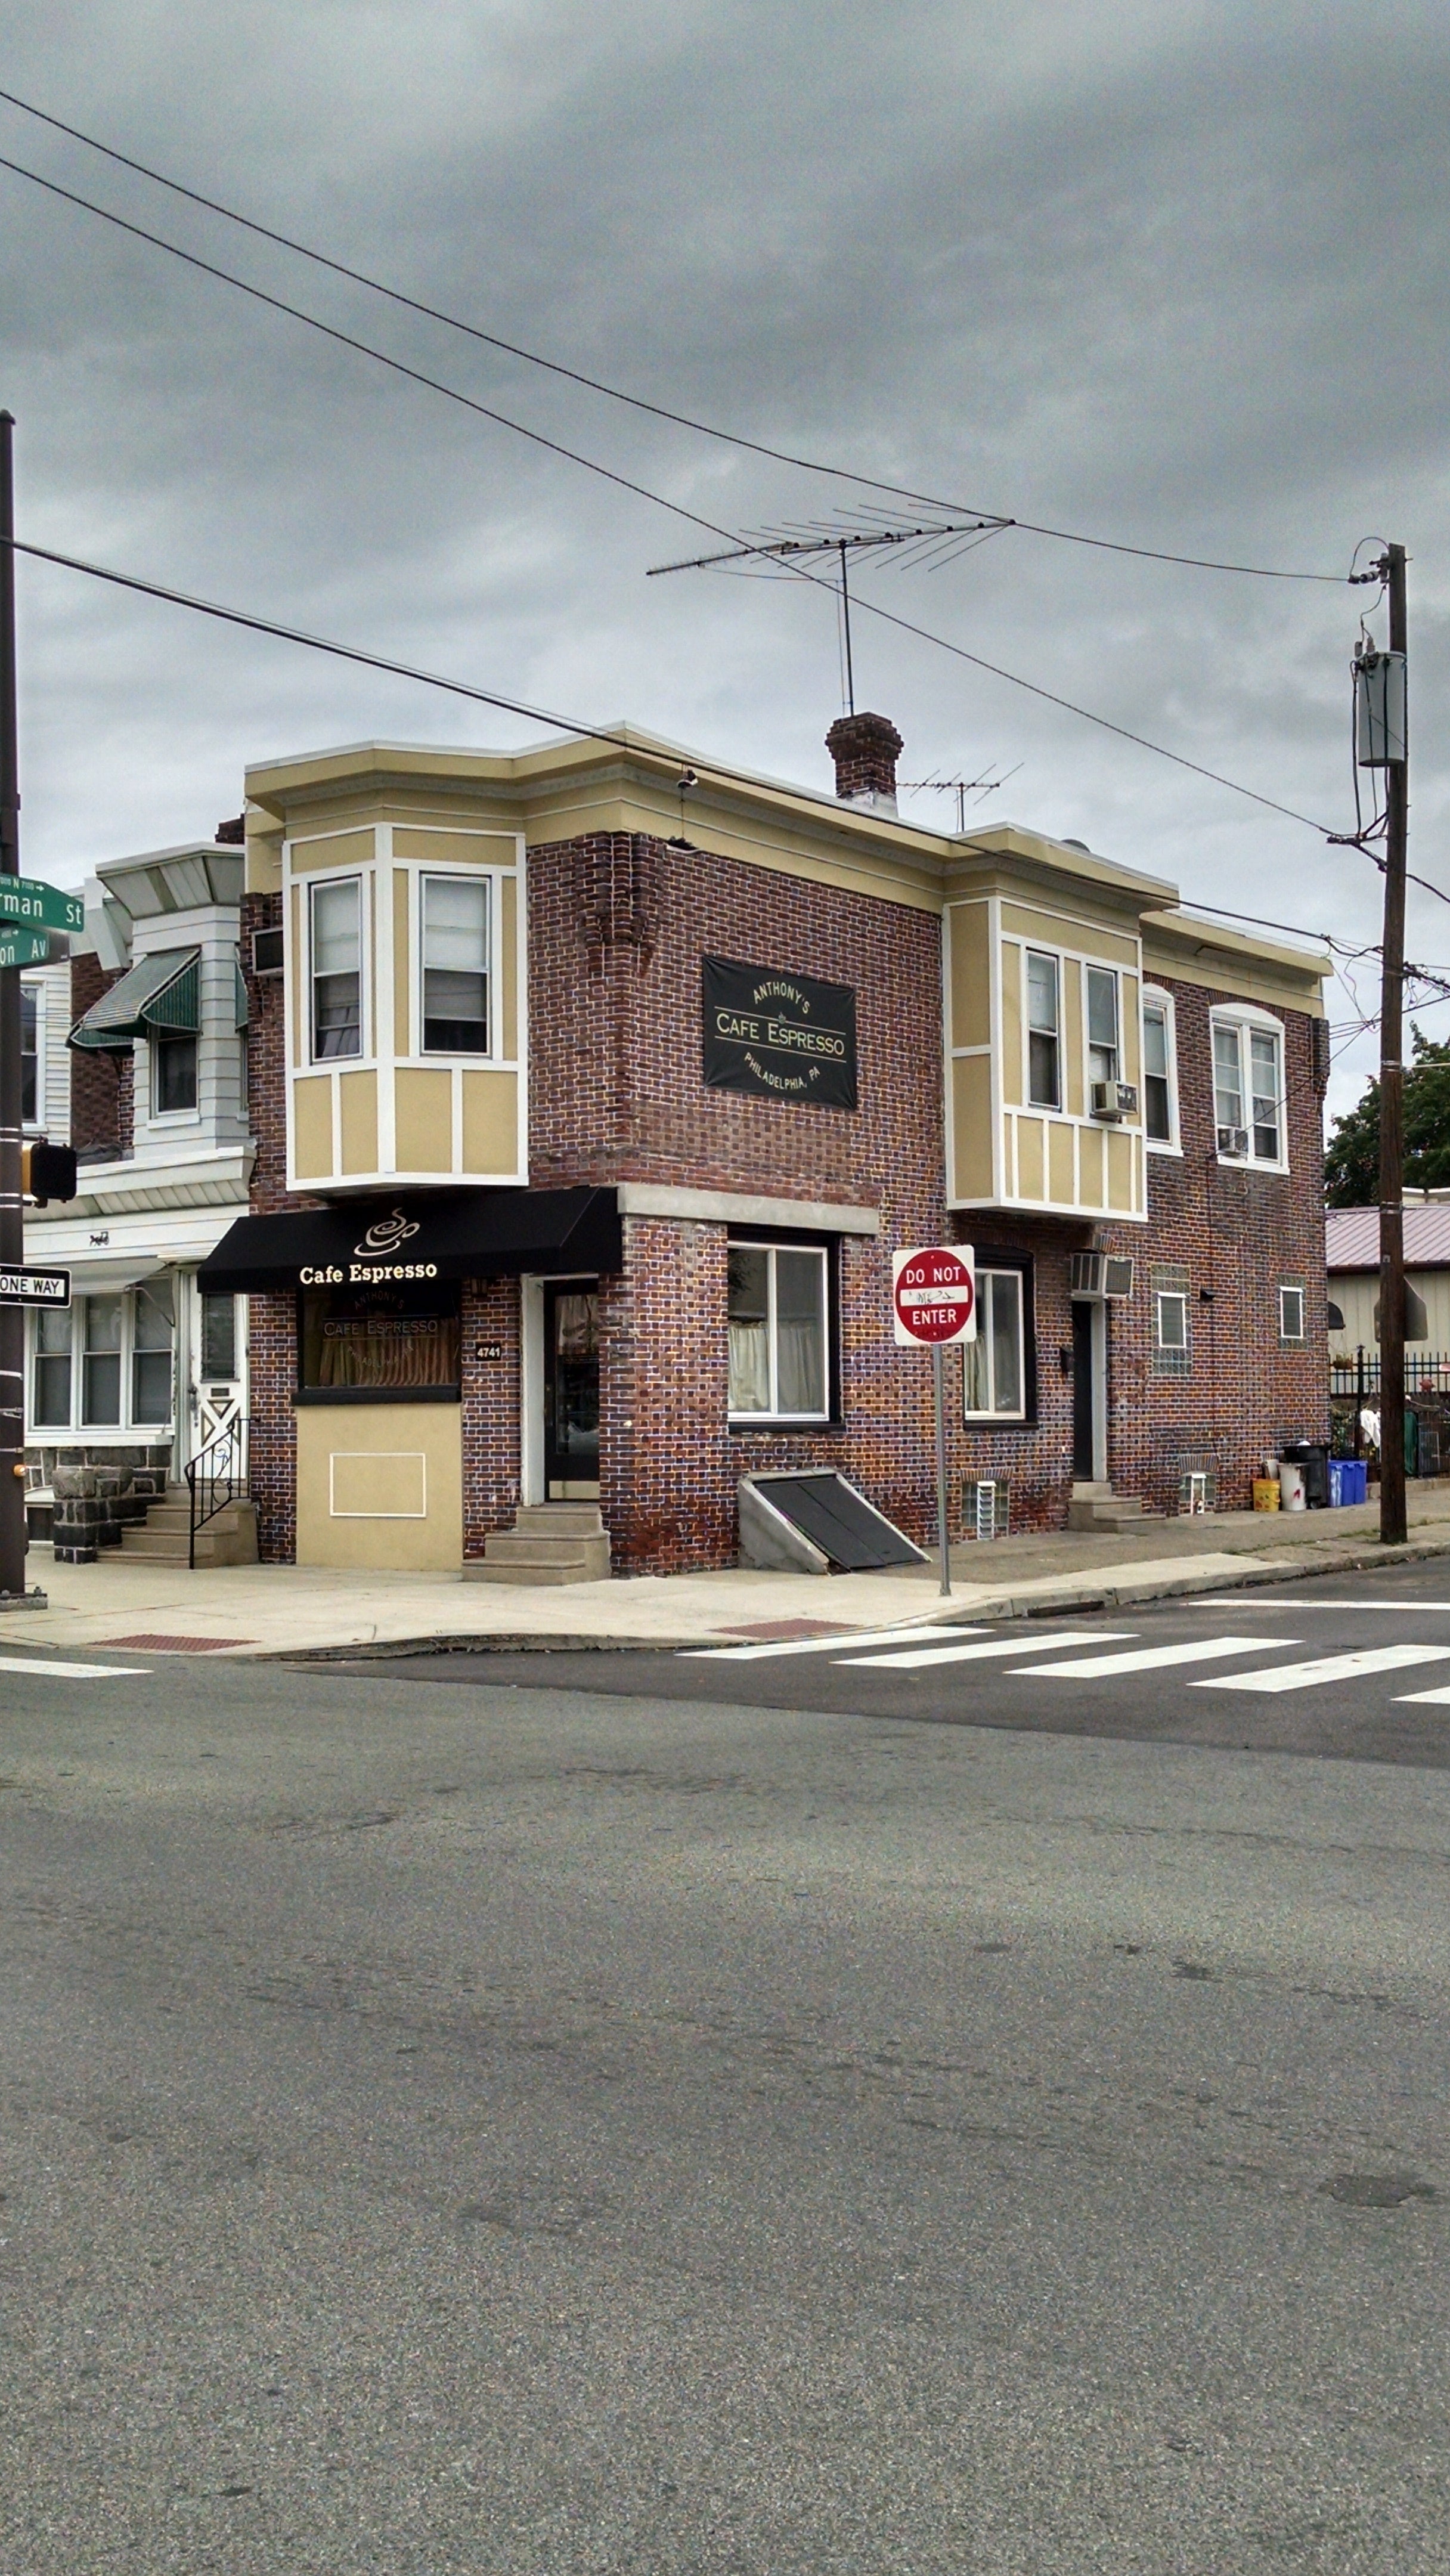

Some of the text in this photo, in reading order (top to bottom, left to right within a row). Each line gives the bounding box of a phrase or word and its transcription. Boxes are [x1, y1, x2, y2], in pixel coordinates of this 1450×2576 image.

[13, 878, 19, 889] N
[66, 904, 81, 924] St
[31, 939, 46, 959] Av
[753, 982, 810, 1014] ANTHONY'S
[717, 1013, 844, 1055] CAFE ESPRESSO
[744, 1052, 820, 1090] PHILADELPHIA, PA
[300, 1264, 437, 1284] Cafe Espresso
[906, 1267, 961, 1284] DO NOT
[0, 1277, 59, 1294] ONE WAY
[912, 1308, 956, 1325] ENTER
[324, 1320, 438, 1336] CAFE ESPRESSO
[477, 1348, 501, 1358] 4741
